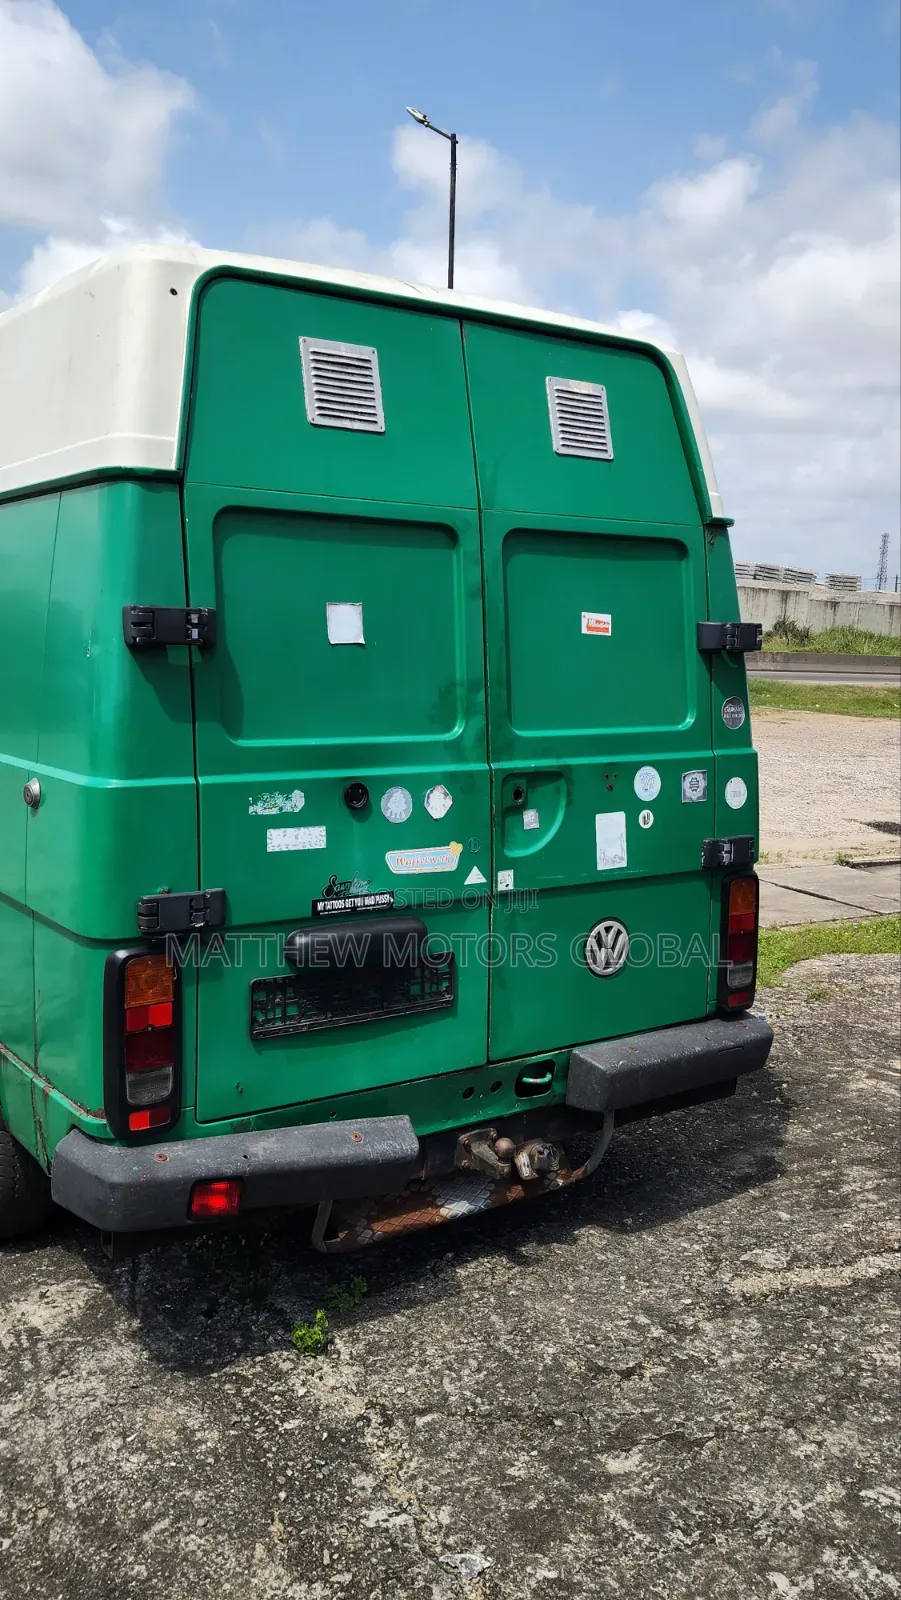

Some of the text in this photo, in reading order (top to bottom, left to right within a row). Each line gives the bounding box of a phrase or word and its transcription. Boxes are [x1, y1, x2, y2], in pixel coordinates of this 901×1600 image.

[317, 901, 325, 911] MY
[325, 899, 345, 910] TATTOOS
[345, 898, 355, 908] GET
[354, 896, 364, 907] YOU
